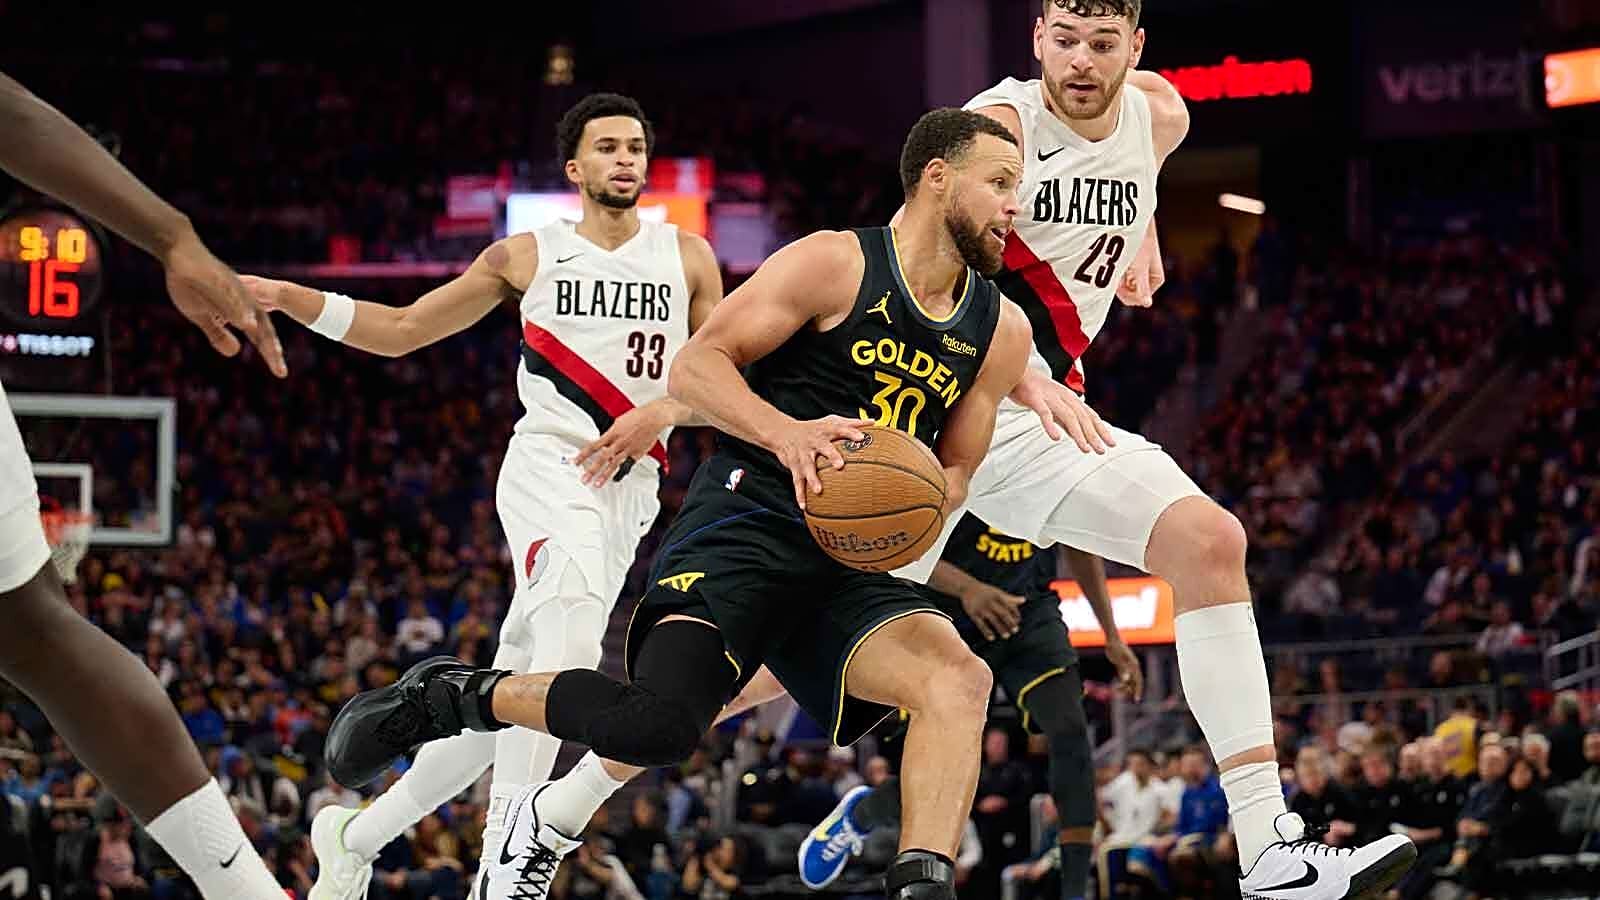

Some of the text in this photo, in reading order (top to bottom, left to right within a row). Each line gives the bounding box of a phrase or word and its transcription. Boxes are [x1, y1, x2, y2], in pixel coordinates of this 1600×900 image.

[1032, 177, 1138, 226] BLAZERS
[1073, 233, 1125, 288] 23
[28, 258, 80, 317] 16
[555, 280, 671, 322] BLAZERS
[626, 331, 666, 380] 33
[942, 333, 977, 357] Rakuten
[851, 338, 961, 409] GOLDEN
[858, 370, 926, 437] 30
[814, 525, 908, 553] Wilson
[976, 533, 1033, 563] STATE
